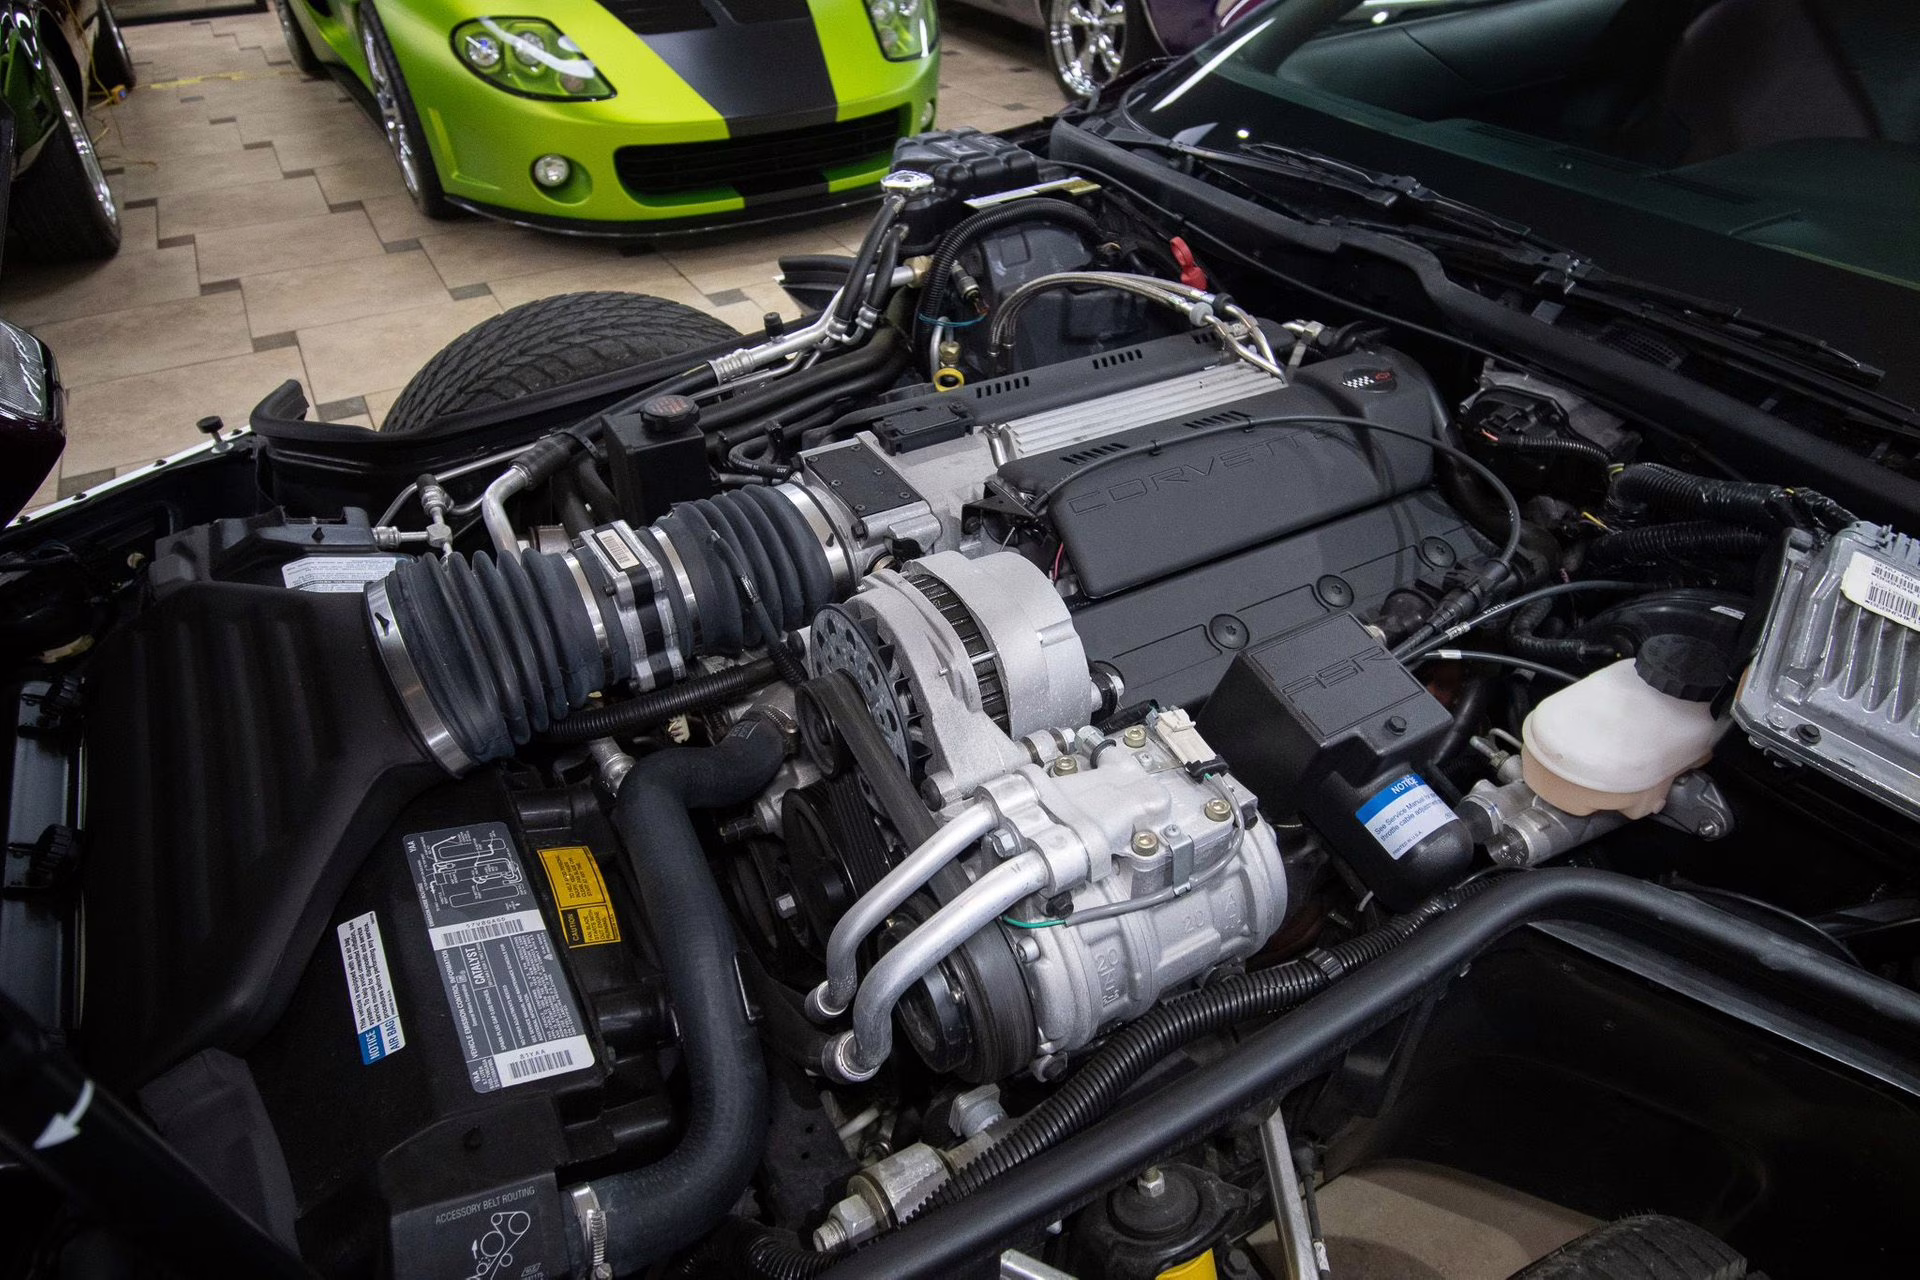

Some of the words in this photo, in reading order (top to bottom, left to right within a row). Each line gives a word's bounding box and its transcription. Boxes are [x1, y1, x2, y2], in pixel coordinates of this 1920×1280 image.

[1391, 774, 1419, 795] NOTICE
[1374, 823, 1388, 836] See
[1385, 809, 1407, 830] Service
[1406, 796, 1426, 815] Manual
[1380, 820, 1400, 842] throttle
[1399, 809, 1416, 826] cable
[407, 840, 416, 852] YAA
[567, 914, 580, 941] CAUTION
[591, 921, 600, 939] STARTS
[594, 911, 602, 928] ENGINE
[354, 950, 362, 973] unwanted
[362, 952, 372, 977] diagnostic
[369, 947, 379, 974] performing
[442, 949, 455, 983] INFORMATION
[465, 946, 485, 984] CATALYST
[1097, 948, 1119, 973] 20
[351, 970, 360, 994] equipped
[363, 998, 369, 1006] To
[379, 990, 388, 1019] procedures
[452, 983, 463, 1008] CONTROL
[373, 1003, 381, 1022] service
[459, 1008, 471, 1034] EMISSION
[385, 1019, 396, 1037] BAG
[366, 1029, 379, 1060] NOTICE
[389, 1035, 399, 1051] AIR
[467, 1034, 478, 1057] VEHICLE
[472, 1070, 480, 1083] YAA
[435, 1202, 482, 1225] ACCESSORY
[483, 1196, 500, 1210] BELT
[502, 1186, 535, 1204] ROUTING
